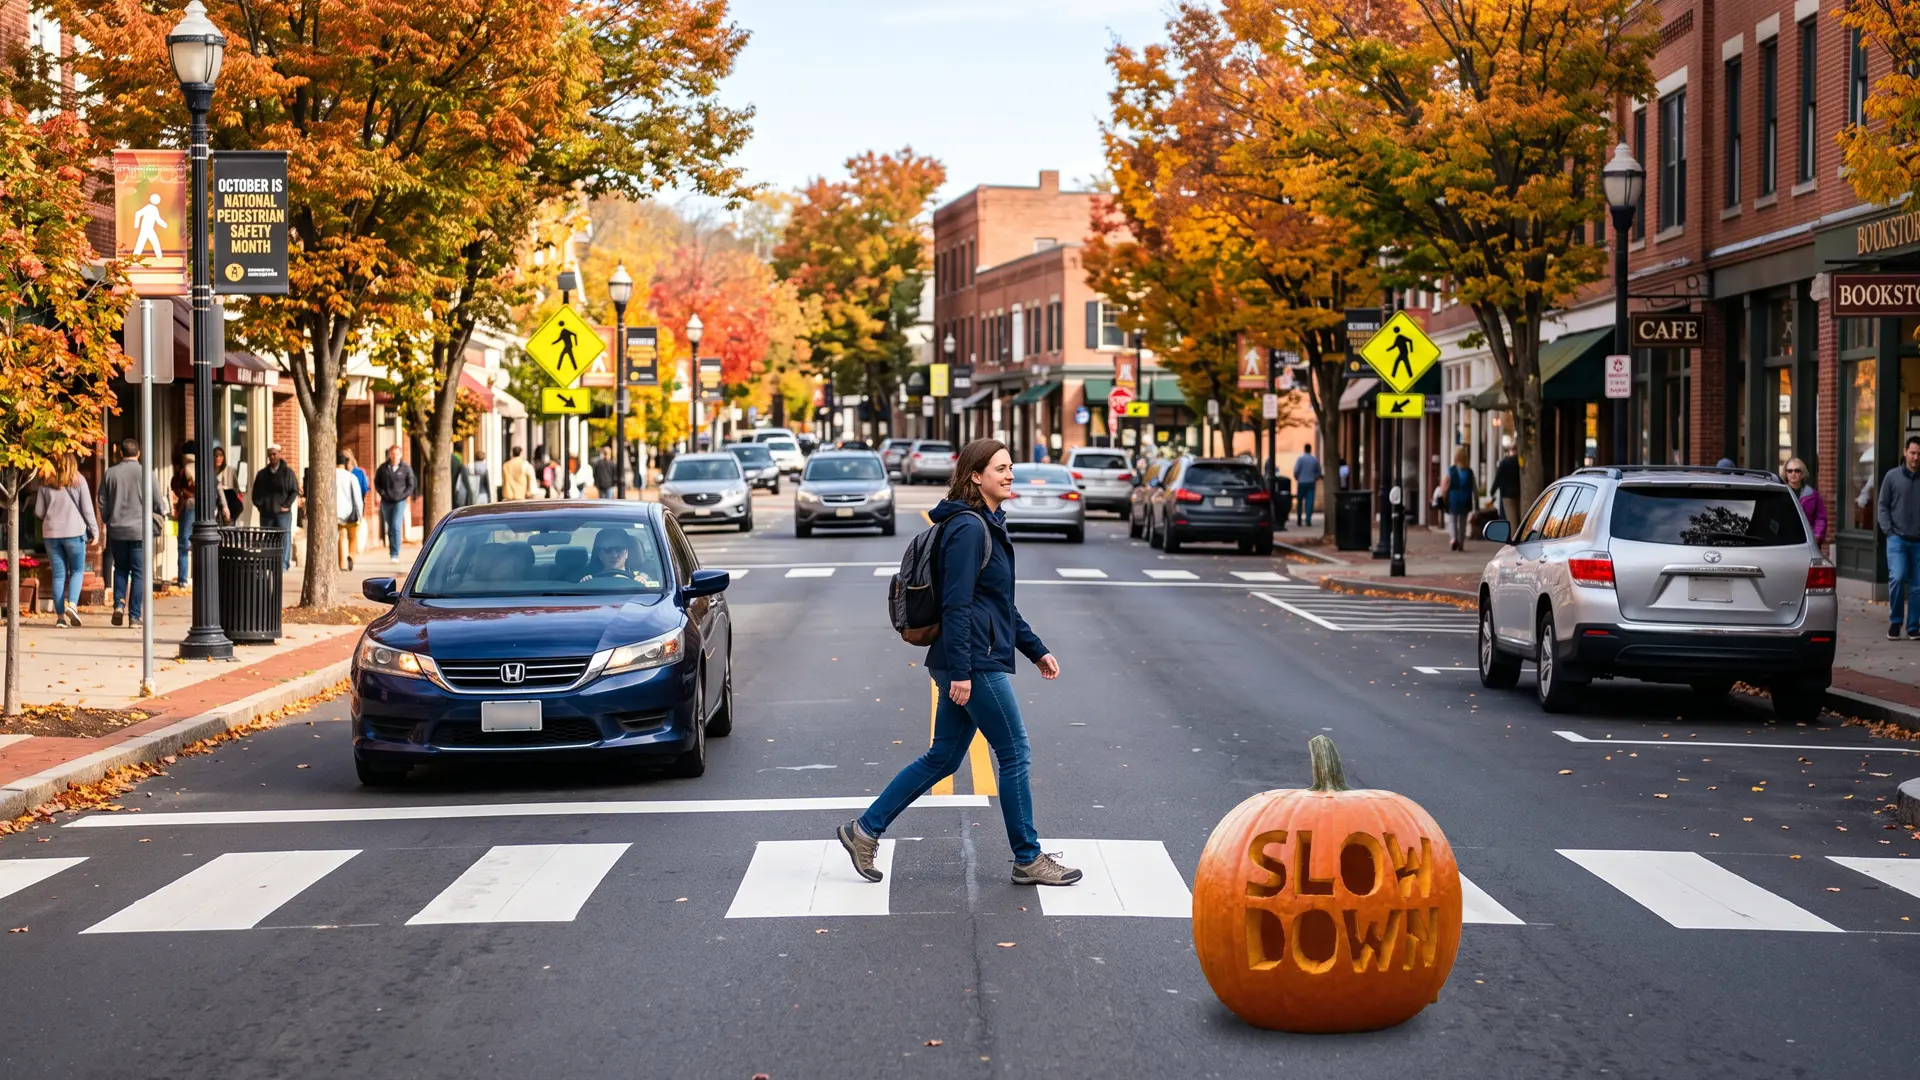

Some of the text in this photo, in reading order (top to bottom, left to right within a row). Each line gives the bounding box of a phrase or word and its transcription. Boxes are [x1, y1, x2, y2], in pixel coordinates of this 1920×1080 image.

[218, 178, 283, 193] OCTOBER IS
[224, 194, 277, 208] NATIONAL
[217, 209, 285, 223] PEDESTRIAN
[230, 224, 272, 238] SAFETY
[231, 240, 271, 253] MONTH
[1639, 320, 1698, 340] CAFE
[1245, 830, 1432, 899] SLOW
[1245, 907, 1439, 974] DOWN
